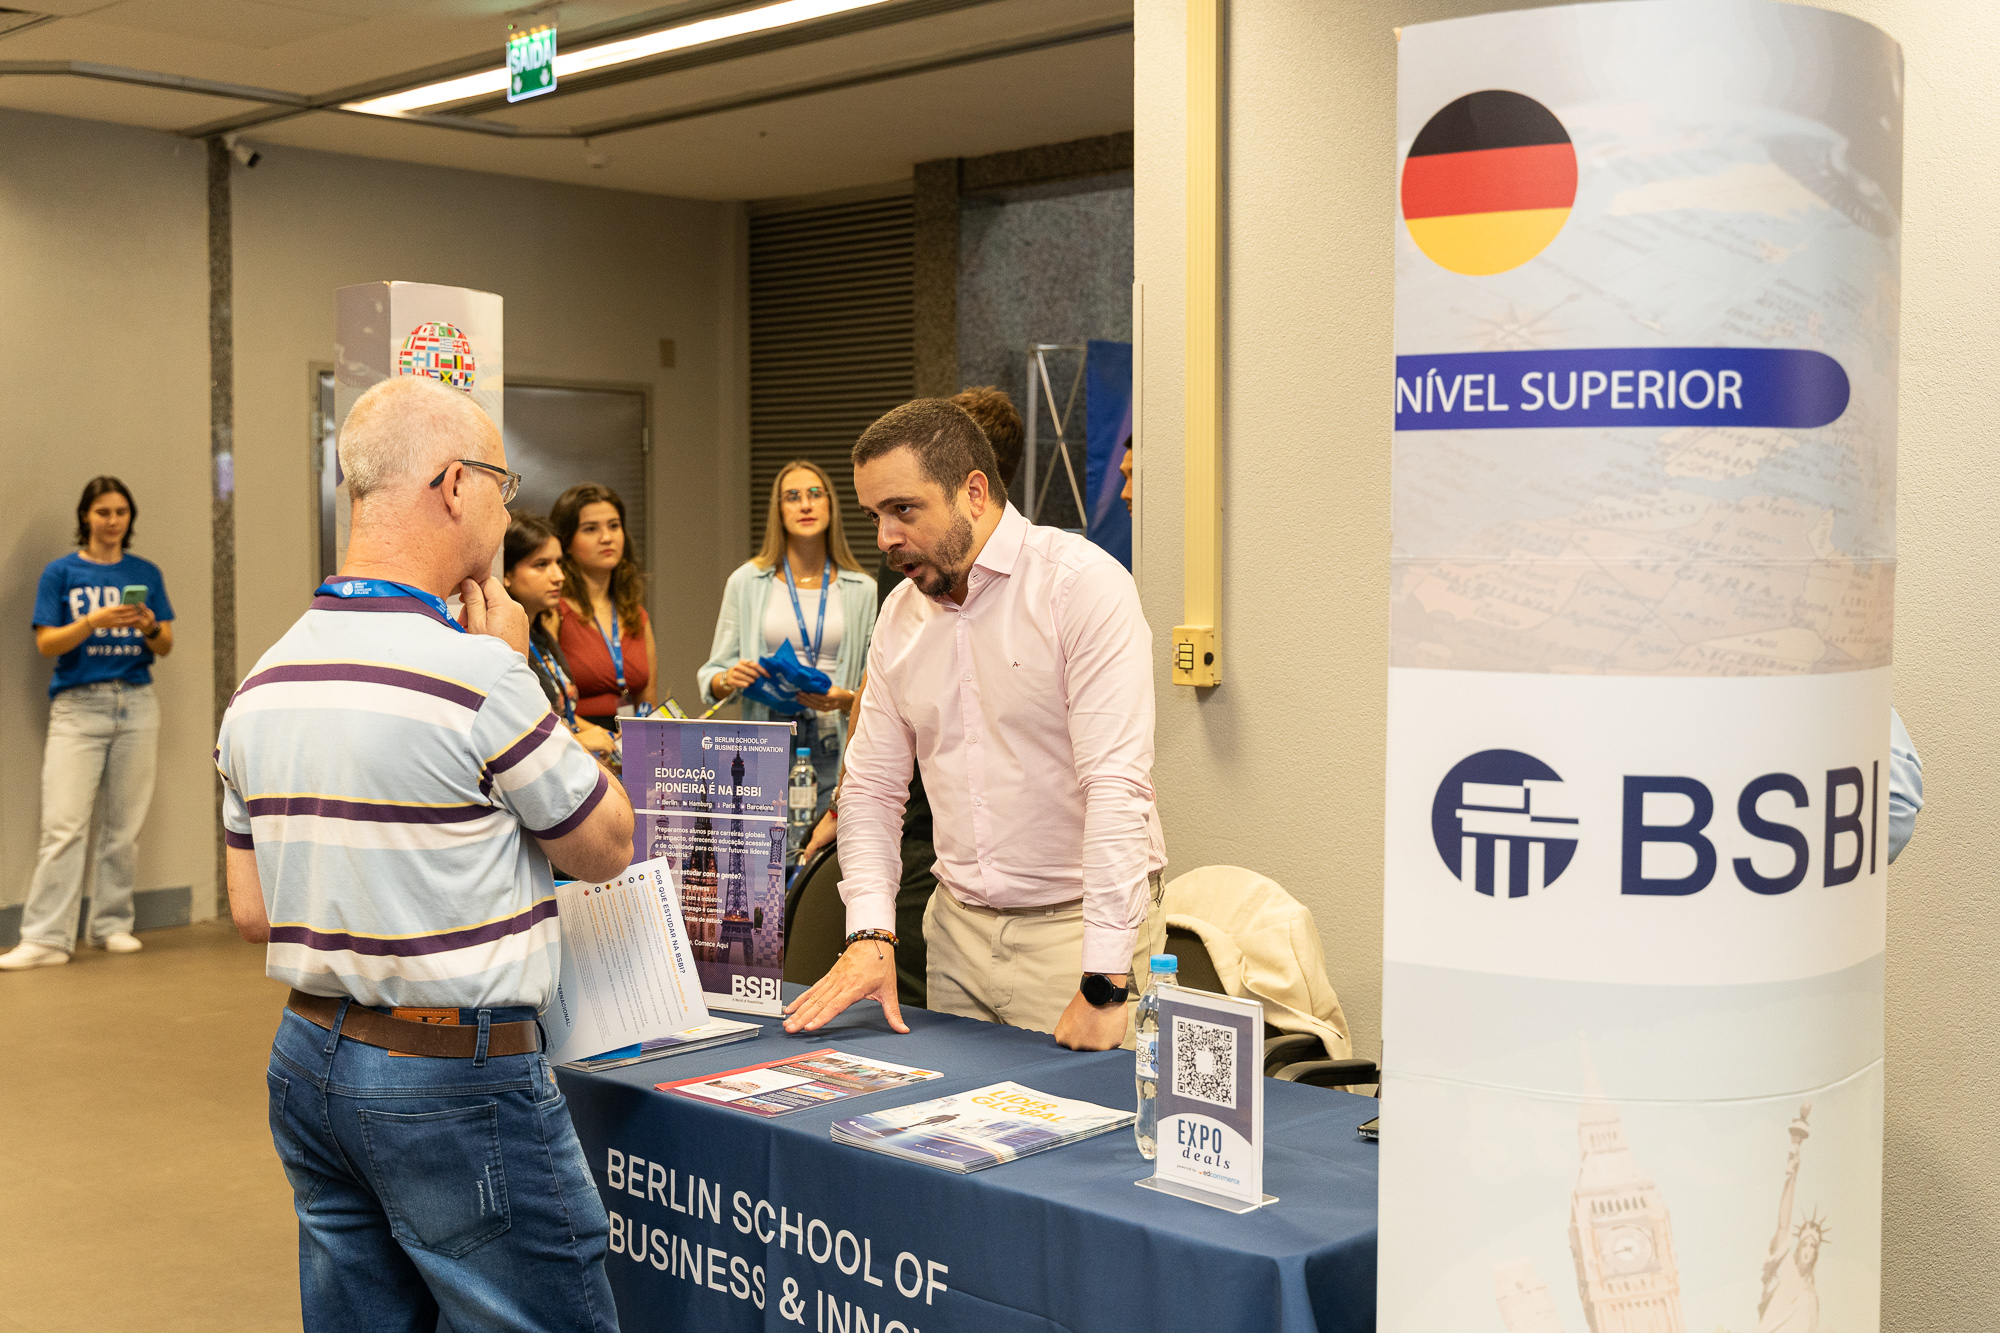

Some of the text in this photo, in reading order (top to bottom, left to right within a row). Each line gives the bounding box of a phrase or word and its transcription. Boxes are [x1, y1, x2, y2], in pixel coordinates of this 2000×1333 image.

[1397, 368, 1743, 413] NÍVEL SUPERIOR
[86, 645, 142, 656] WIZARD
[714, 736, 735, 744] BERLIN
[735, 737, 759, 745] SCHOOL
[714, 744, 742, 752] BUSINESS
[655, 766, 716, 782] EDUCAÇÃO
[655, 781, 761, 797] PIONEIRA É NA BSBI
[688, 800, 713, 809] Hamburg
[746, 803, 774, 811] Barcelona
[655, 826, 689, 835] Preparamos
[689, 827, 706, 835] alunos
[720, 830, 744, 838] carreiras
[745, 831, 766, 840] globais
[1620, 760, 1879, 896] BSBI
[662, 835, 688, 843] impacto,
[688, 837, 718, 845] oferecendo
[718, 838, 744, 847] educação
[745, 840, 772, 848] acessível
[668, 843, 694, 851] qualidade
[708, 845, 728, 853] cultivar
[728, 847, 749, 855] futuros
[749, 847, 770, 856] líderes
[680, 869, 702, 877] estudar
[653, 869, 686, 974] POR QUE ESTUDAR NA BSBI?
[694, 939, 716, 948] Comece
[716, 941, 729, 950] Aqui
[732, 974, 781, 1001] BSBI
[988, 1090, 1058, 1111] LÍDER
[971, 1096, 1067, 1123] GLOBAL
[1178, 1119, 1222, 1154] EXPO
[1182, 1147, 1230, 1170] deals
[1203, 1170, 1240, 1185] edcommerce
[607, 1148, 949, 1305] BERLIN SCHOOL OF
[609, 1211, 931, 1333] BUSINESS & INN
